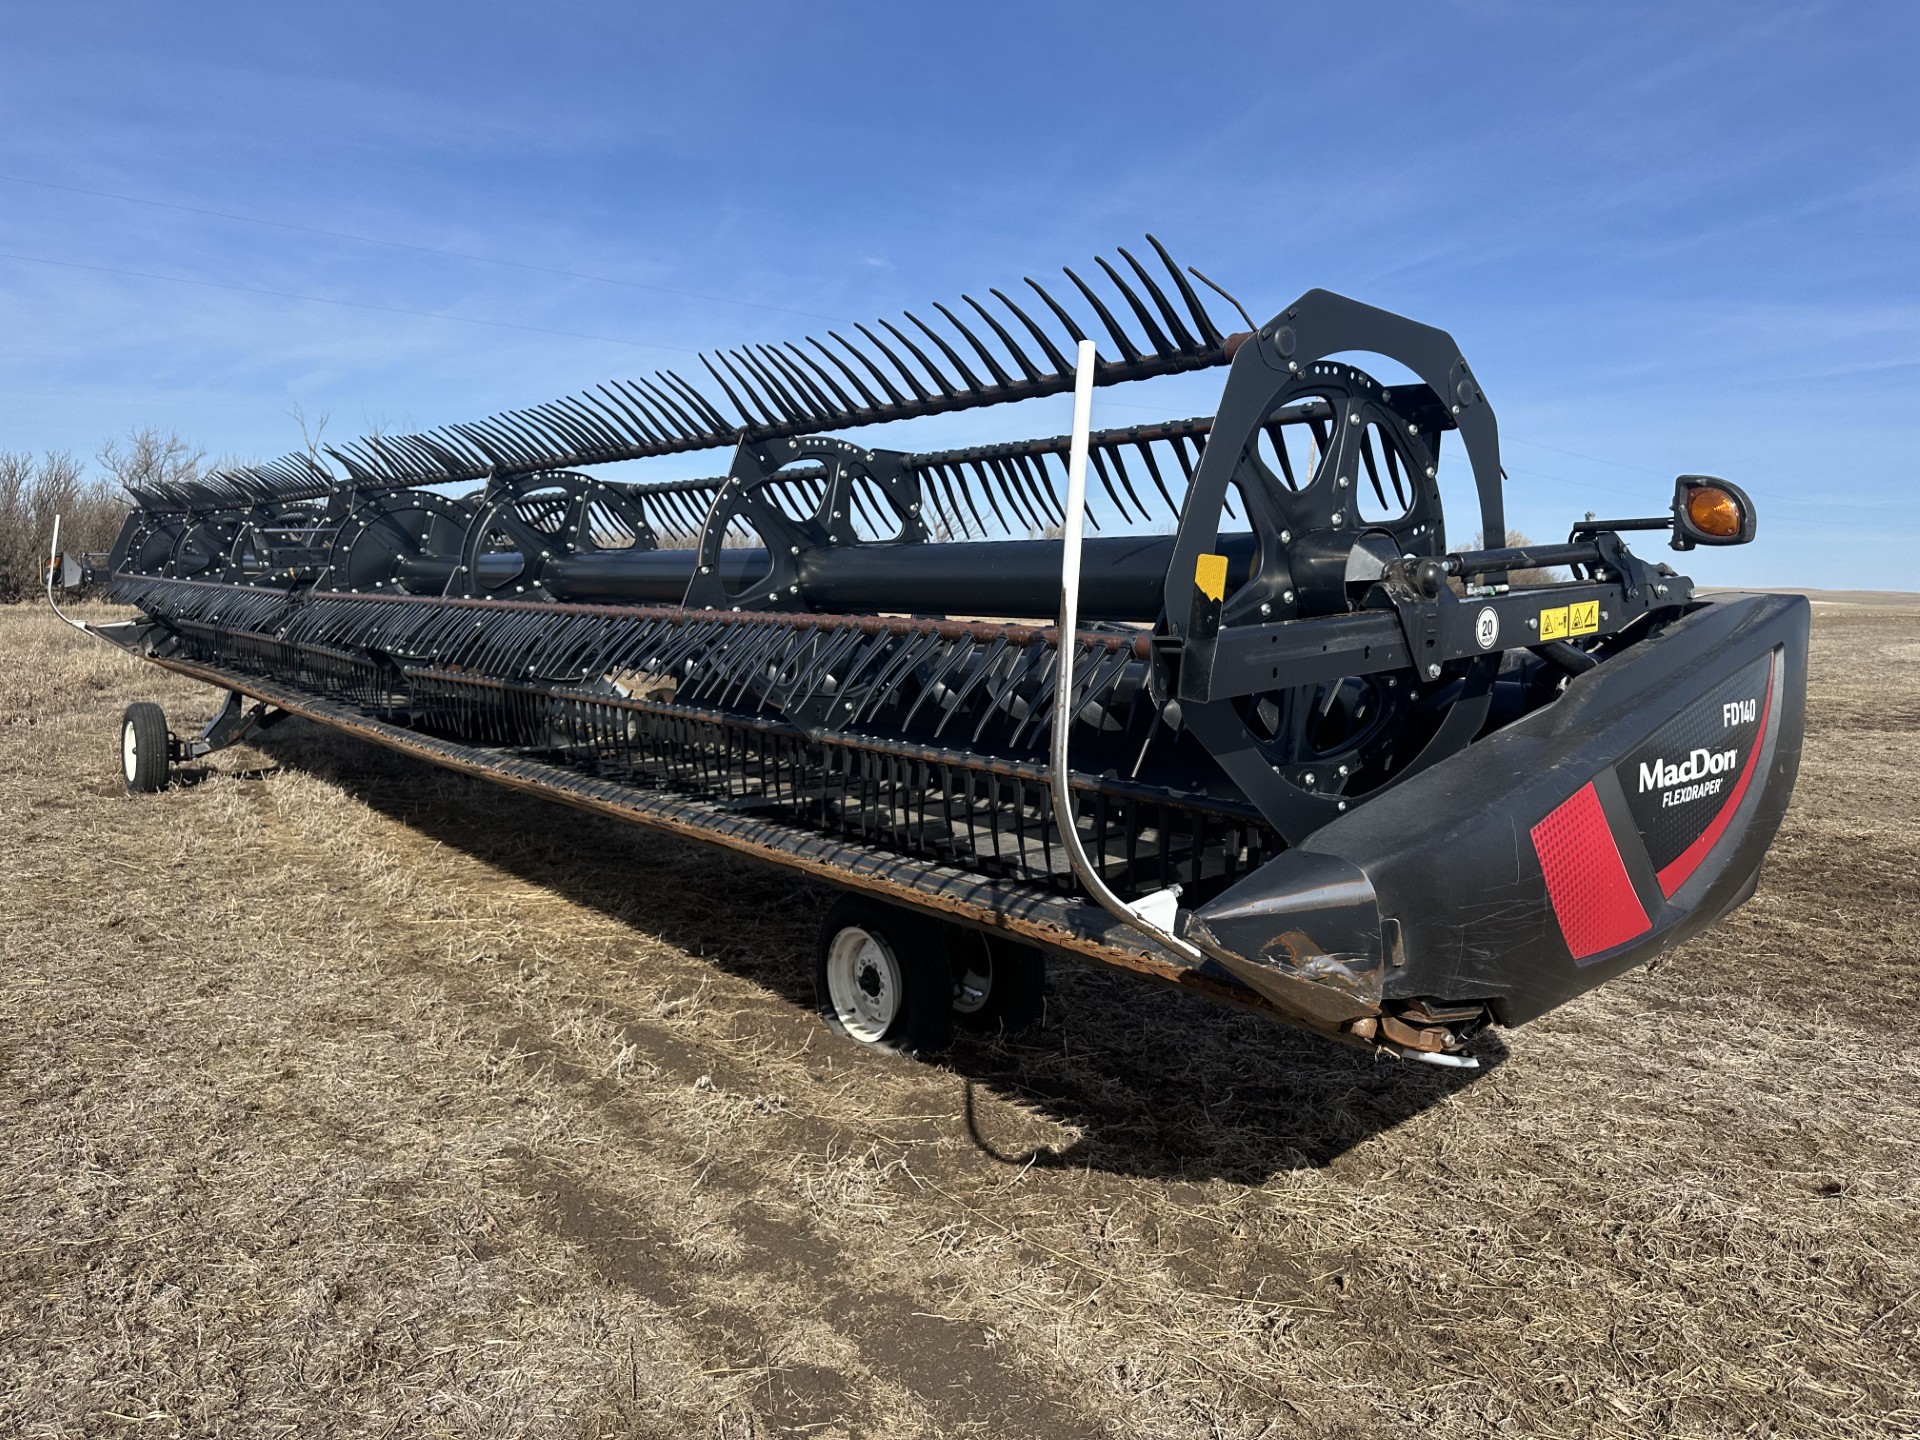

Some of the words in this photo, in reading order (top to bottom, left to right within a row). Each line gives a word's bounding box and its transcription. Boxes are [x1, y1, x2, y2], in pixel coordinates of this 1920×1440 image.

[1482, 619, 1493, 637] 20
[1723, 699, 1756, 728] FD140
[1638, 748, 1736, 793] MacDon
[1662, 779, 1721, 808] FLEXDRAPER
